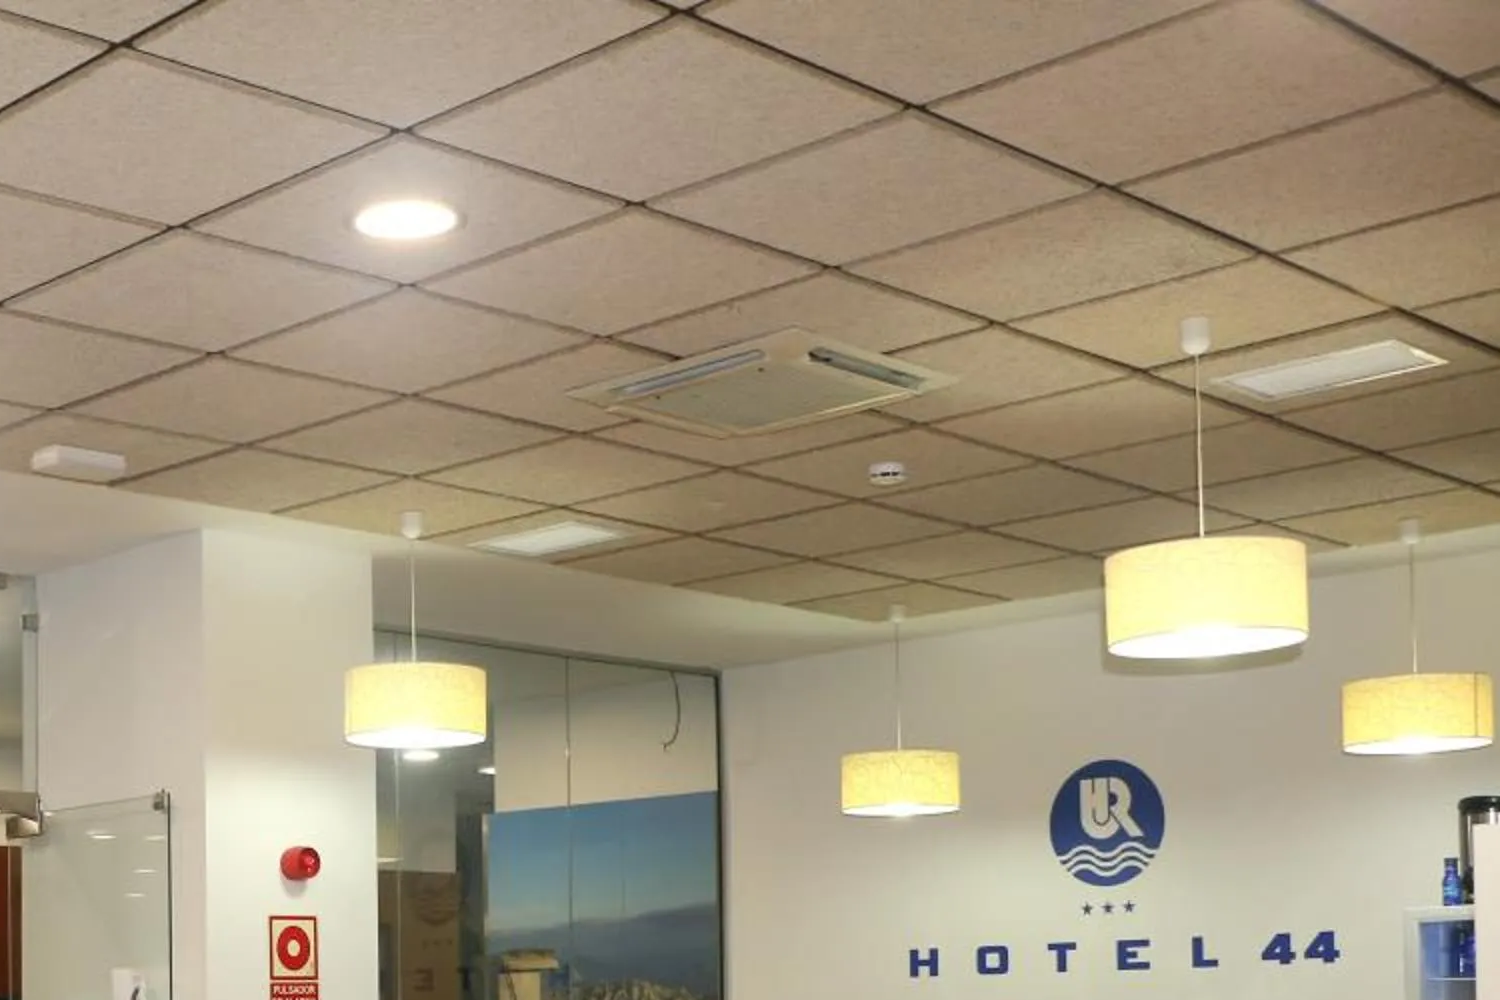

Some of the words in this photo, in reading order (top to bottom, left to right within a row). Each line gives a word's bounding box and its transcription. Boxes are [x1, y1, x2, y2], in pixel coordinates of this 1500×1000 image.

[909, 935, 1219, 978] HOTEL
[1260, 930, 1341, 965] 44
[273, 984, 317, 995] PULSADOR
